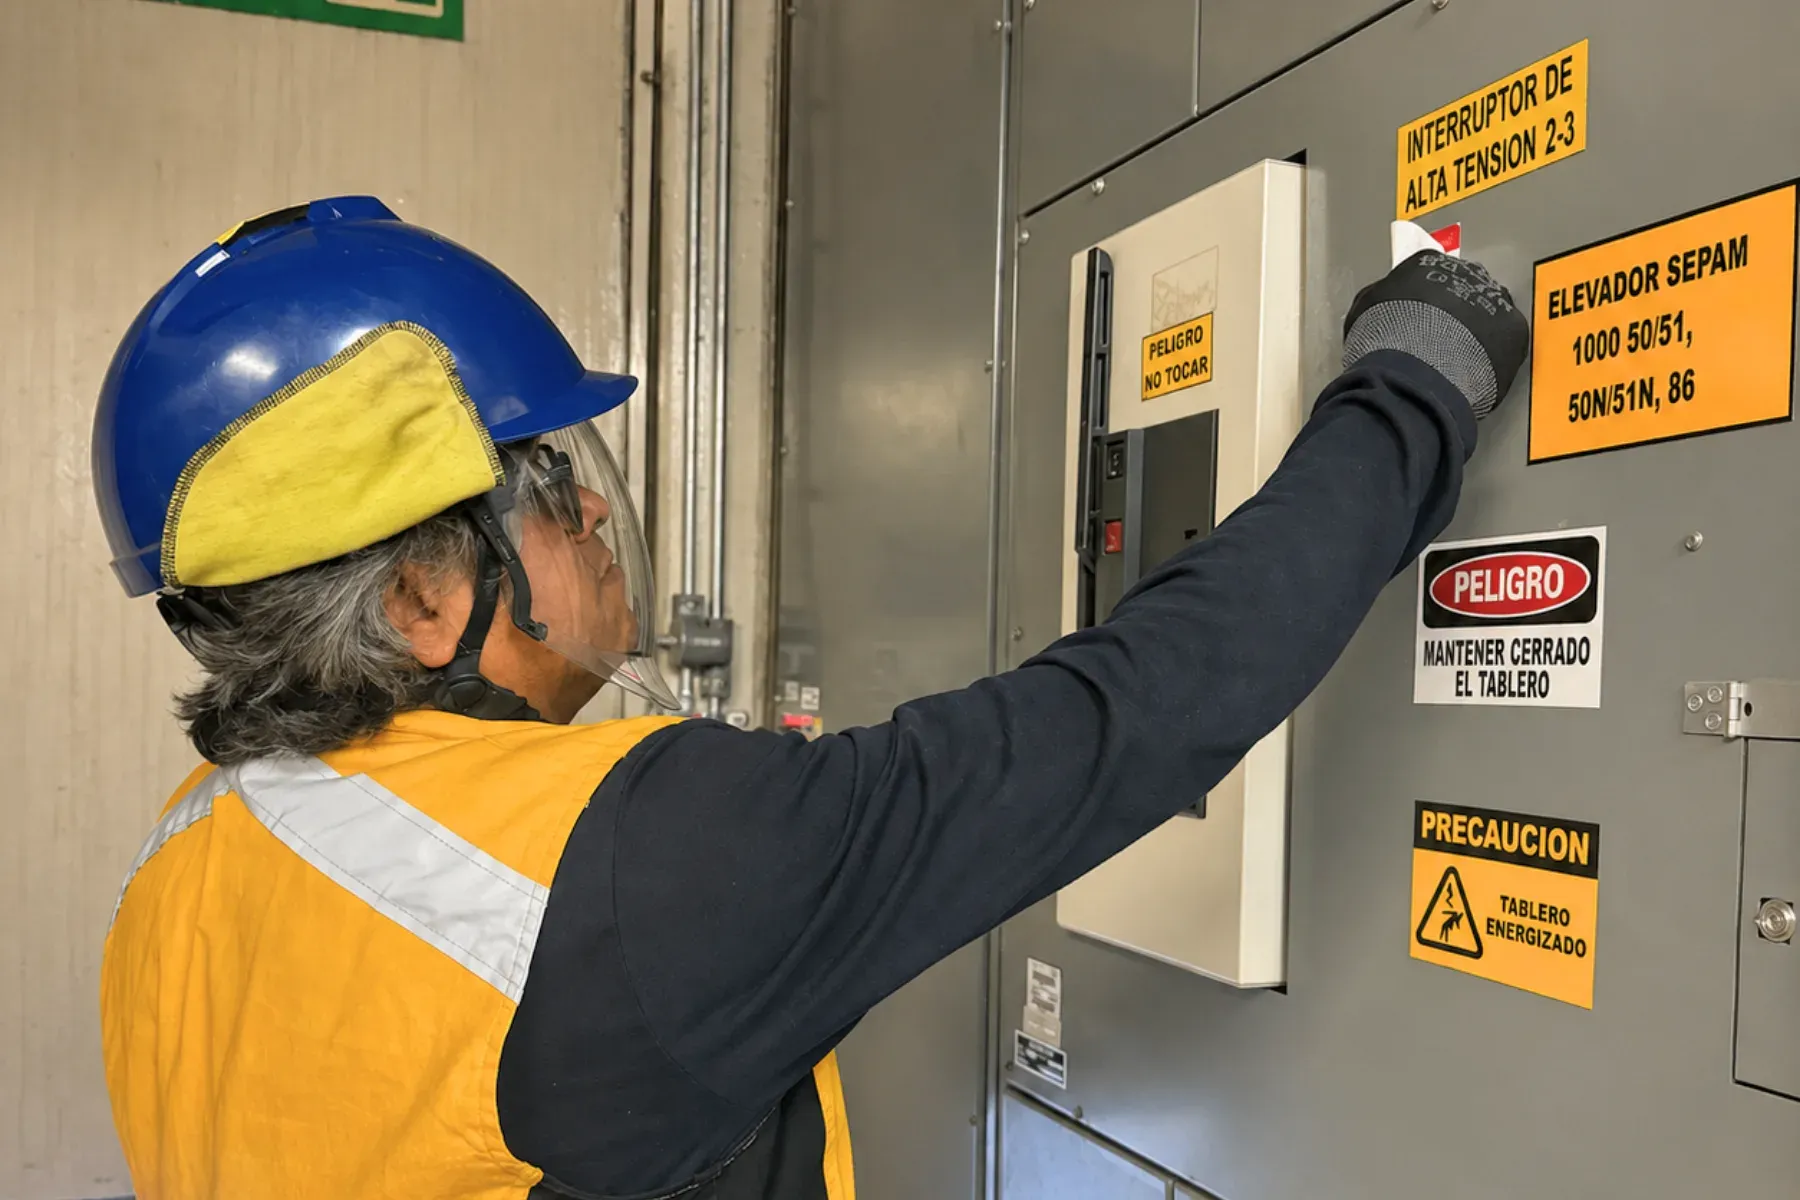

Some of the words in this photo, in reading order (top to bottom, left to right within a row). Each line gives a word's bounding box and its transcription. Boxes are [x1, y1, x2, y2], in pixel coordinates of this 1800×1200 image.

[1407, 73, 1538, 164] INTERRUPTOR
[1545, 55, 1573, 101] DE
[1405, 165, 1448, 213] ALTA
[1453, 125, 1536, 192] TENSION
[1545, 110, 1575, 156] 2-3
[1548, 261, 1659, 320] ELEVADOR
[1666, 234, 1748, 287] SEPAM
[1149, 325, 1203, 361] PELIGRO
[1572, 326, 1620, 366] 1000
[1627, 310, 1693, 354] 50/51,
[1144, 371, 1162, 392] NO
[1165, 355, 1208, 386] TOCAR
[1568, 376, 1660, 424] 50N/51N,
[1668, 368, 1695, 405] 86
[1454, 563, 1565, 604] PELIGRO
[1423, 638, 1505, 667] MANTENER
[1510, 636, 1590, 666] CERRADO
[1455, 670, 1472, 697] EL
[1478, 670, 1550, 699] TABLERO
[1421, 809, 1589, 865] PRECAUCION
[1499, 894, 1570, 927] TABLERO
[1486, 917, 1587, 958] ENERGIZADO
